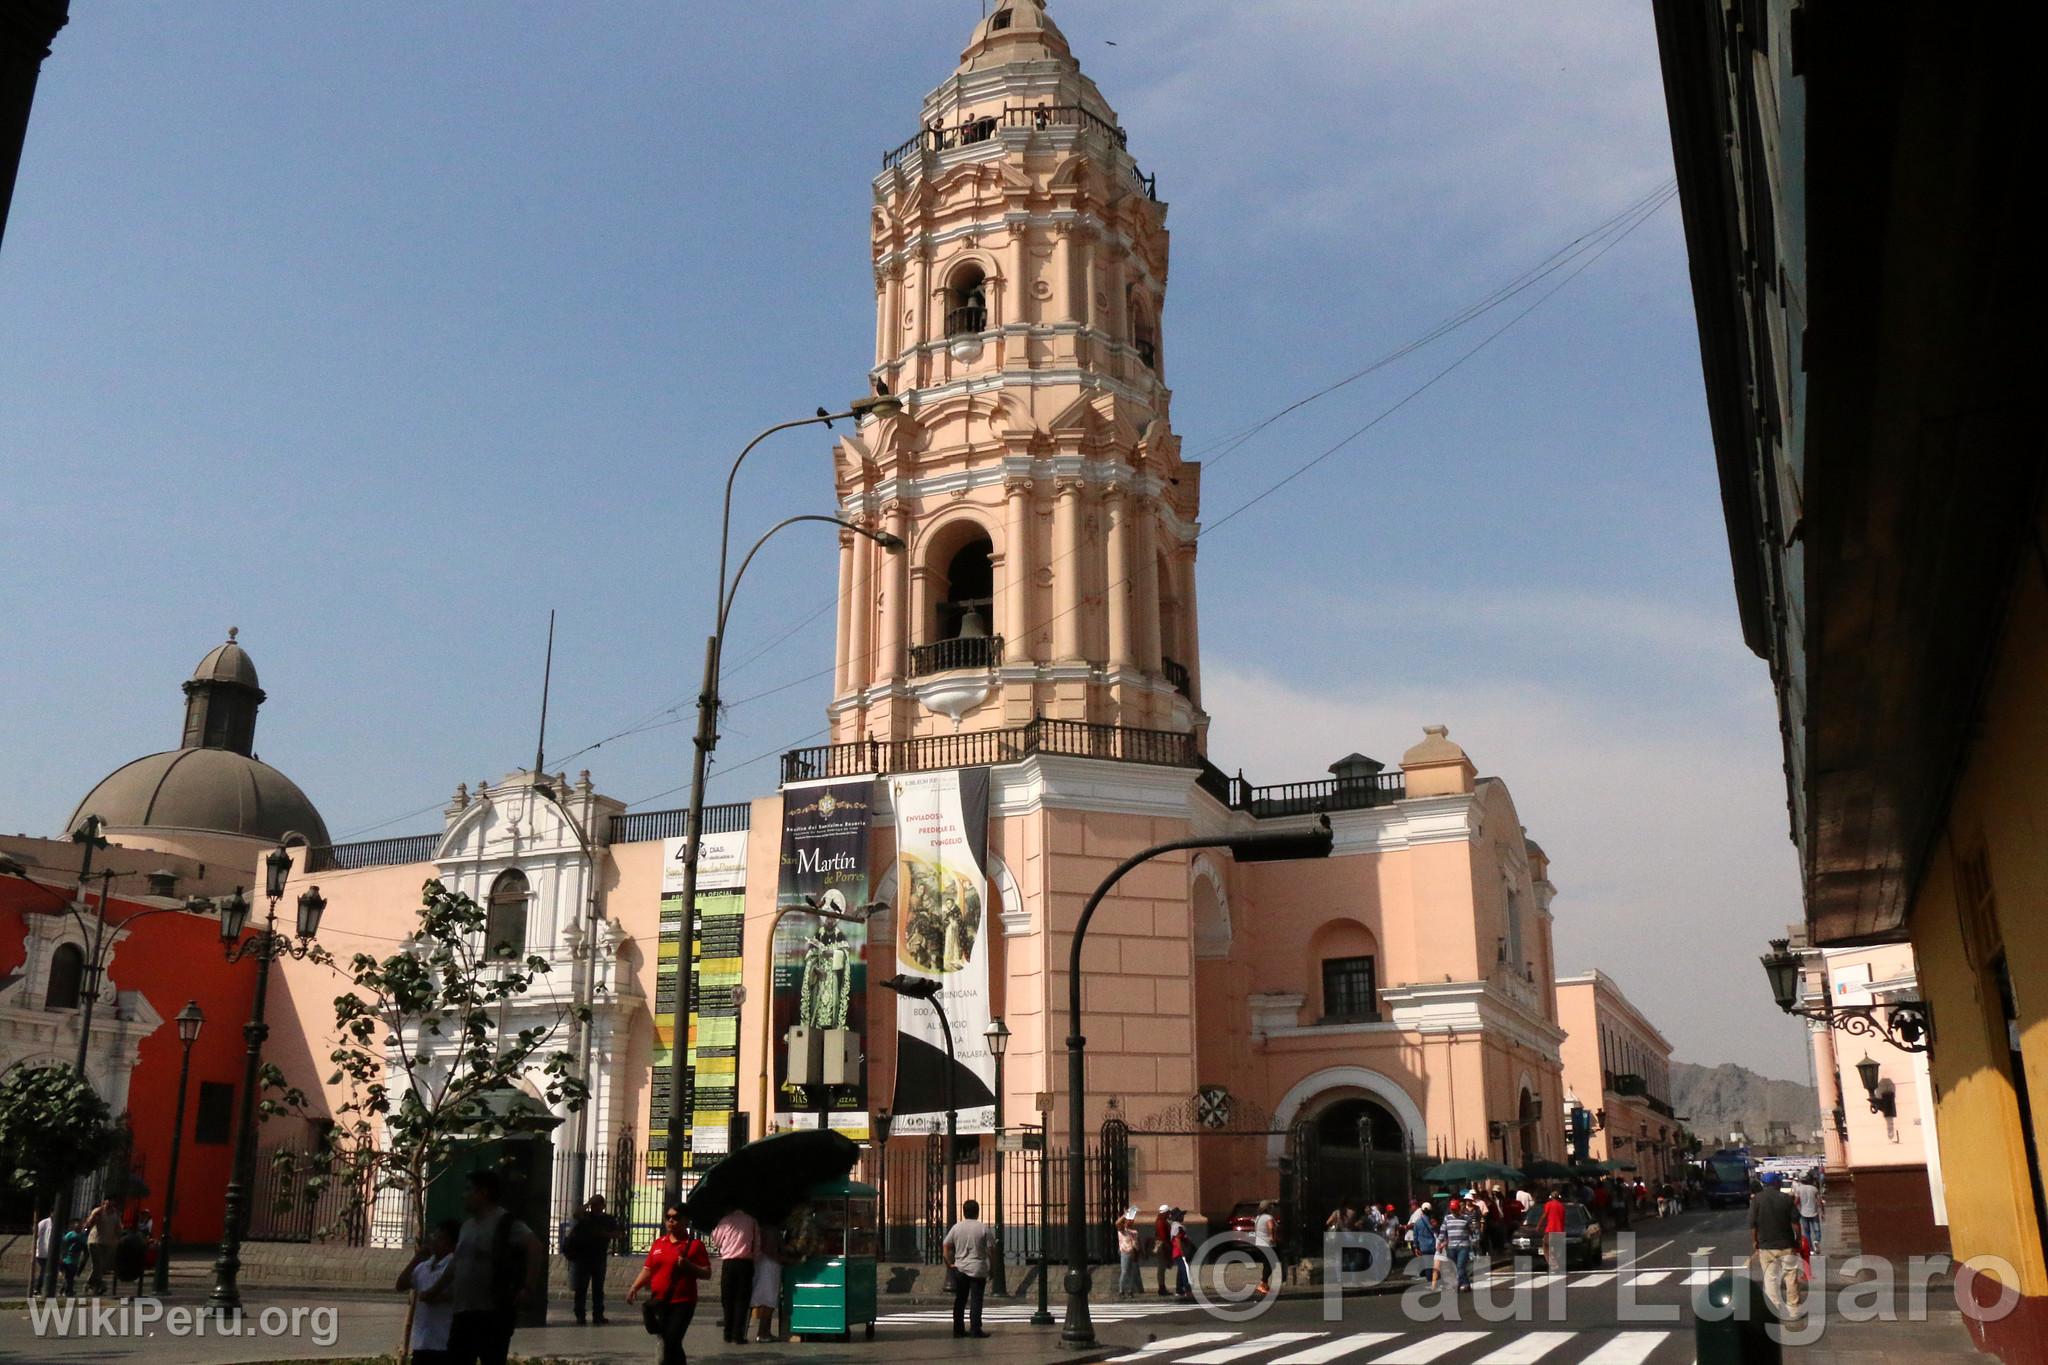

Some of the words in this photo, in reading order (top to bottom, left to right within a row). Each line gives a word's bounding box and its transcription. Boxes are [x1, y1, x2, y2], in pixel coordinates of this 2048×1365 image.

[797, 847, 856, 874] Martín
[824, 872, 834, 885] de
[835, 870, 865, 883] Porres
[913, 1007, 929, 1016] 800
[926, 1022, 936, 1030] AL
[954, 1036, 964, 1044] LA
